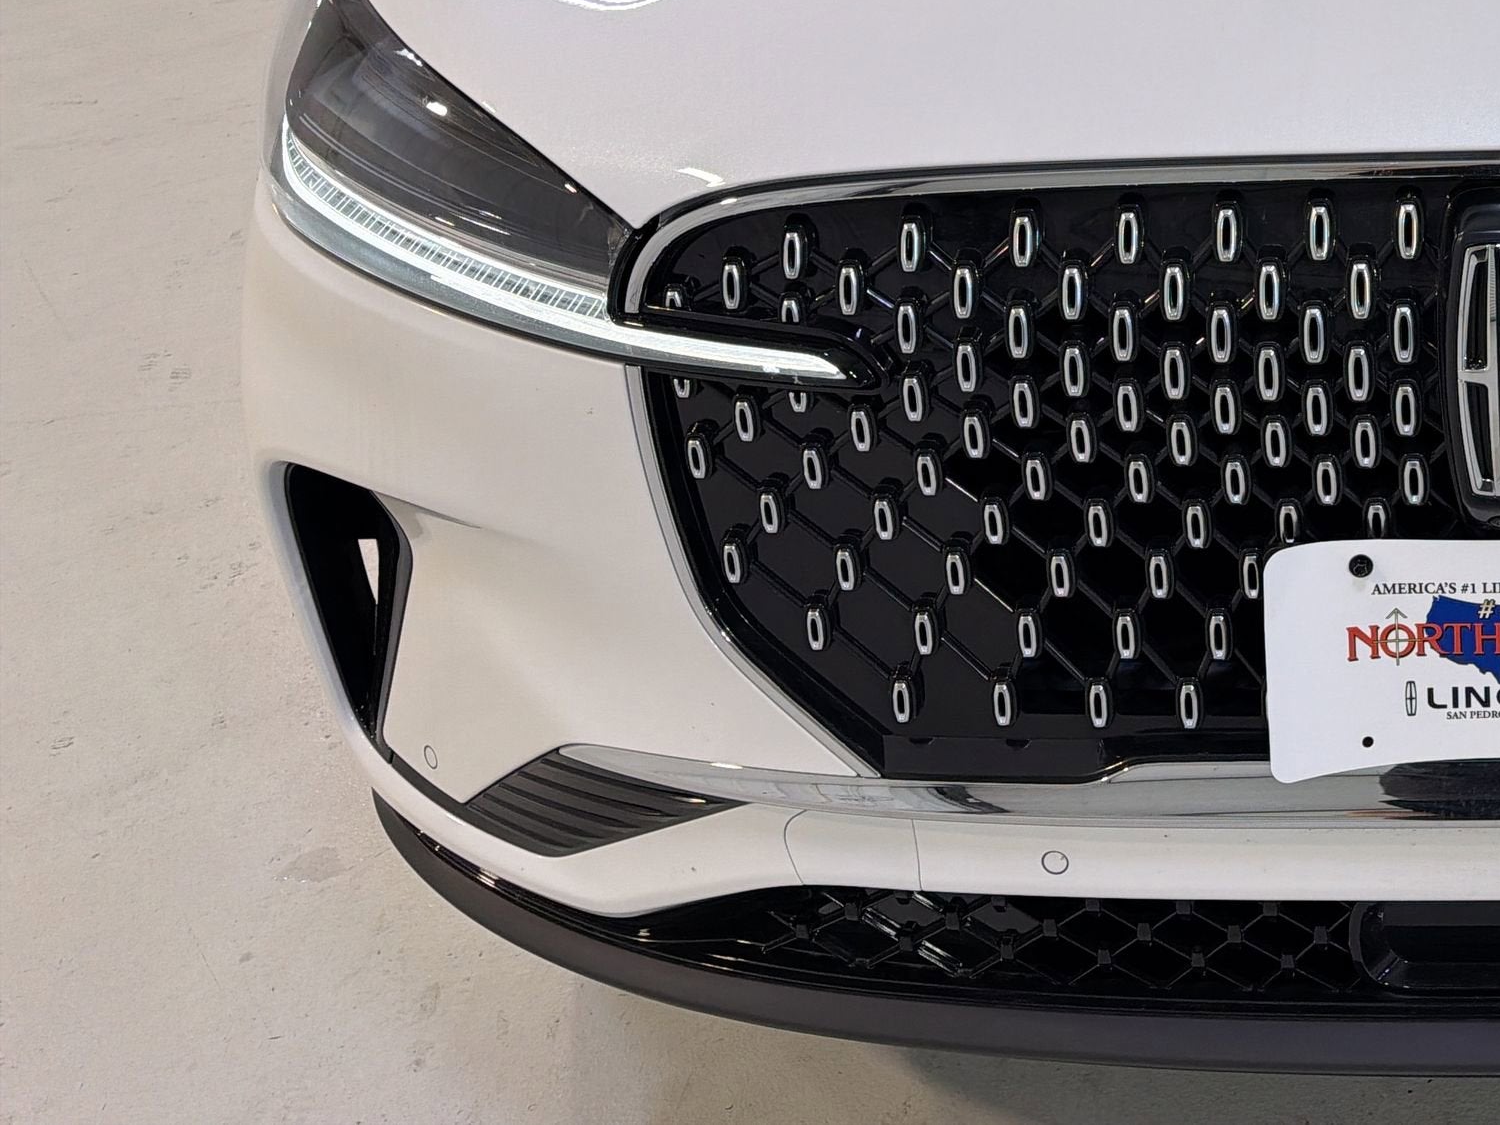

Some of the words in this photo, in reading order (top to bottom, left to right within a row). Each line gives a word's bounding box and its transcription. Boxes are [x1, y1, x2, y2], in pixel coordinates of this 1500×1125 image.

[1371, 581, 1458, 596] AMERICA'S
[1460, 582, 1476, 594] #1
[1446, 710, 1469, 720] SAN
